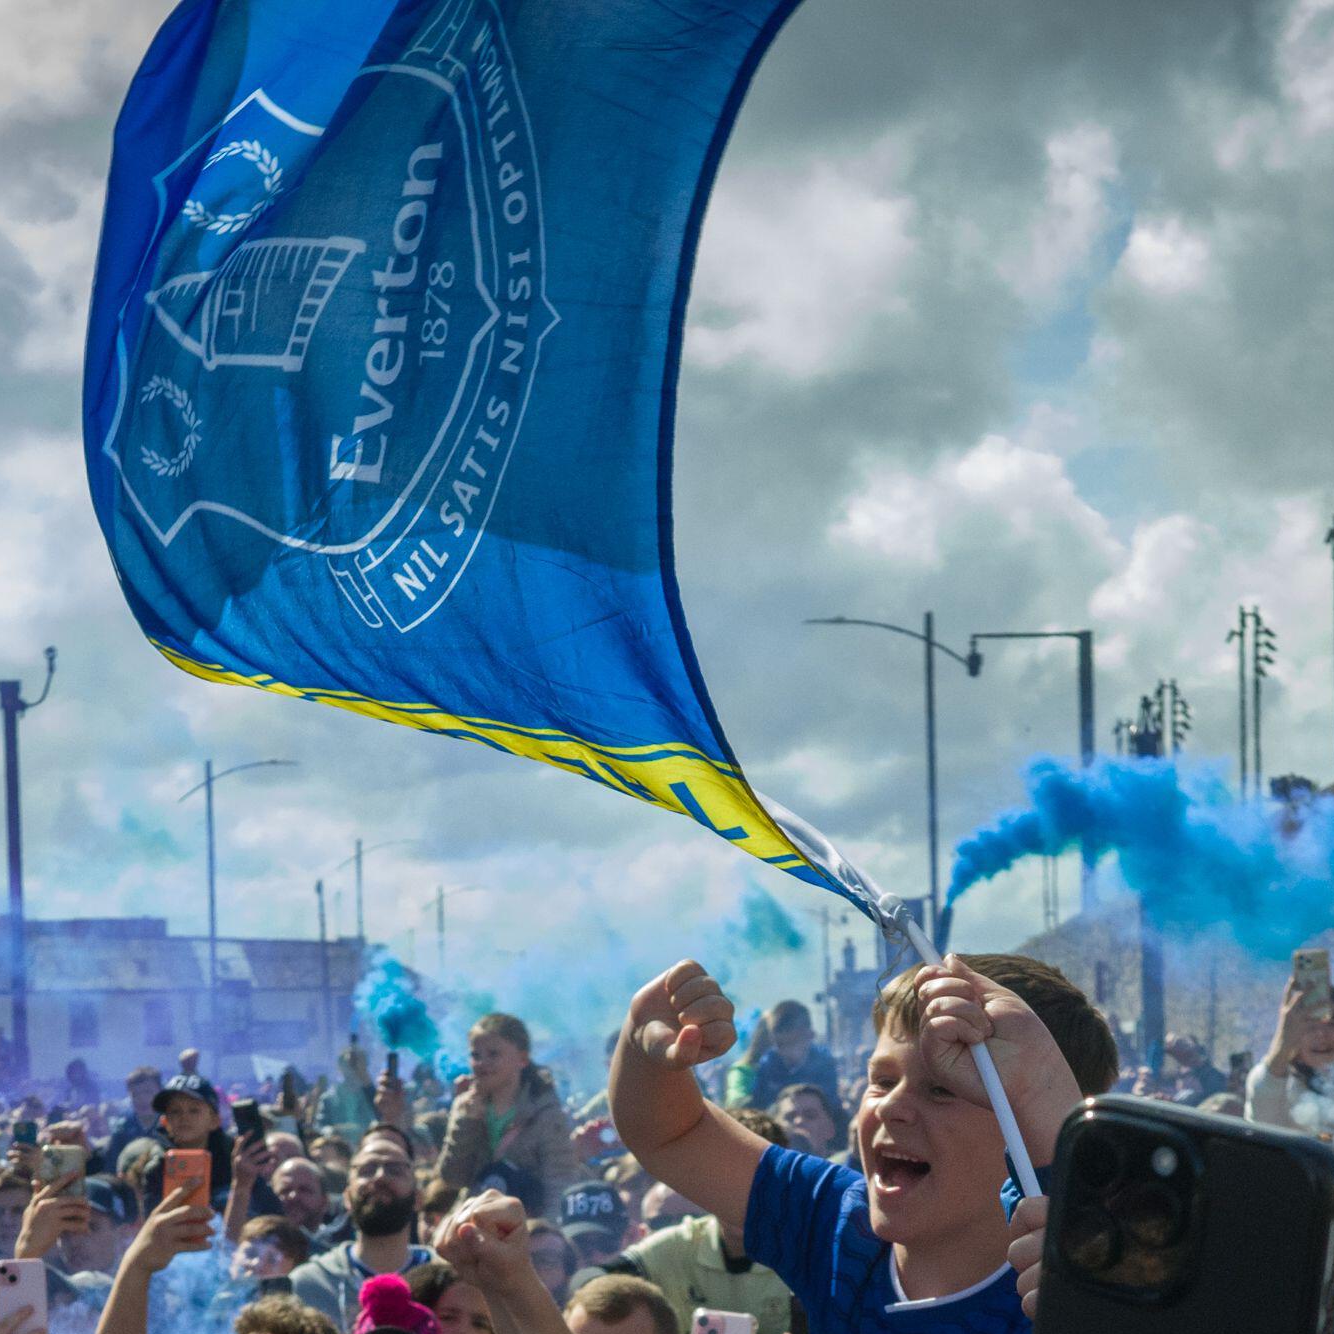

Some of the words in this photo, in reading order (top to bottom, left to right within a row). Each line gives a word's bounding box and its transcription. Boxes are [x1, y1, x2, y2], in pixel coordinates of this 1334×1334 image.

[471, 19, 529, 225] OPTIMUM
[329, 140, 447, 485] Everton
[419, 260, 456, 366] 1878
[499, 248, 532, 374] NISI
[439, 396, 510, 537] SATIS
[392, 539, 449, 601] NIL
